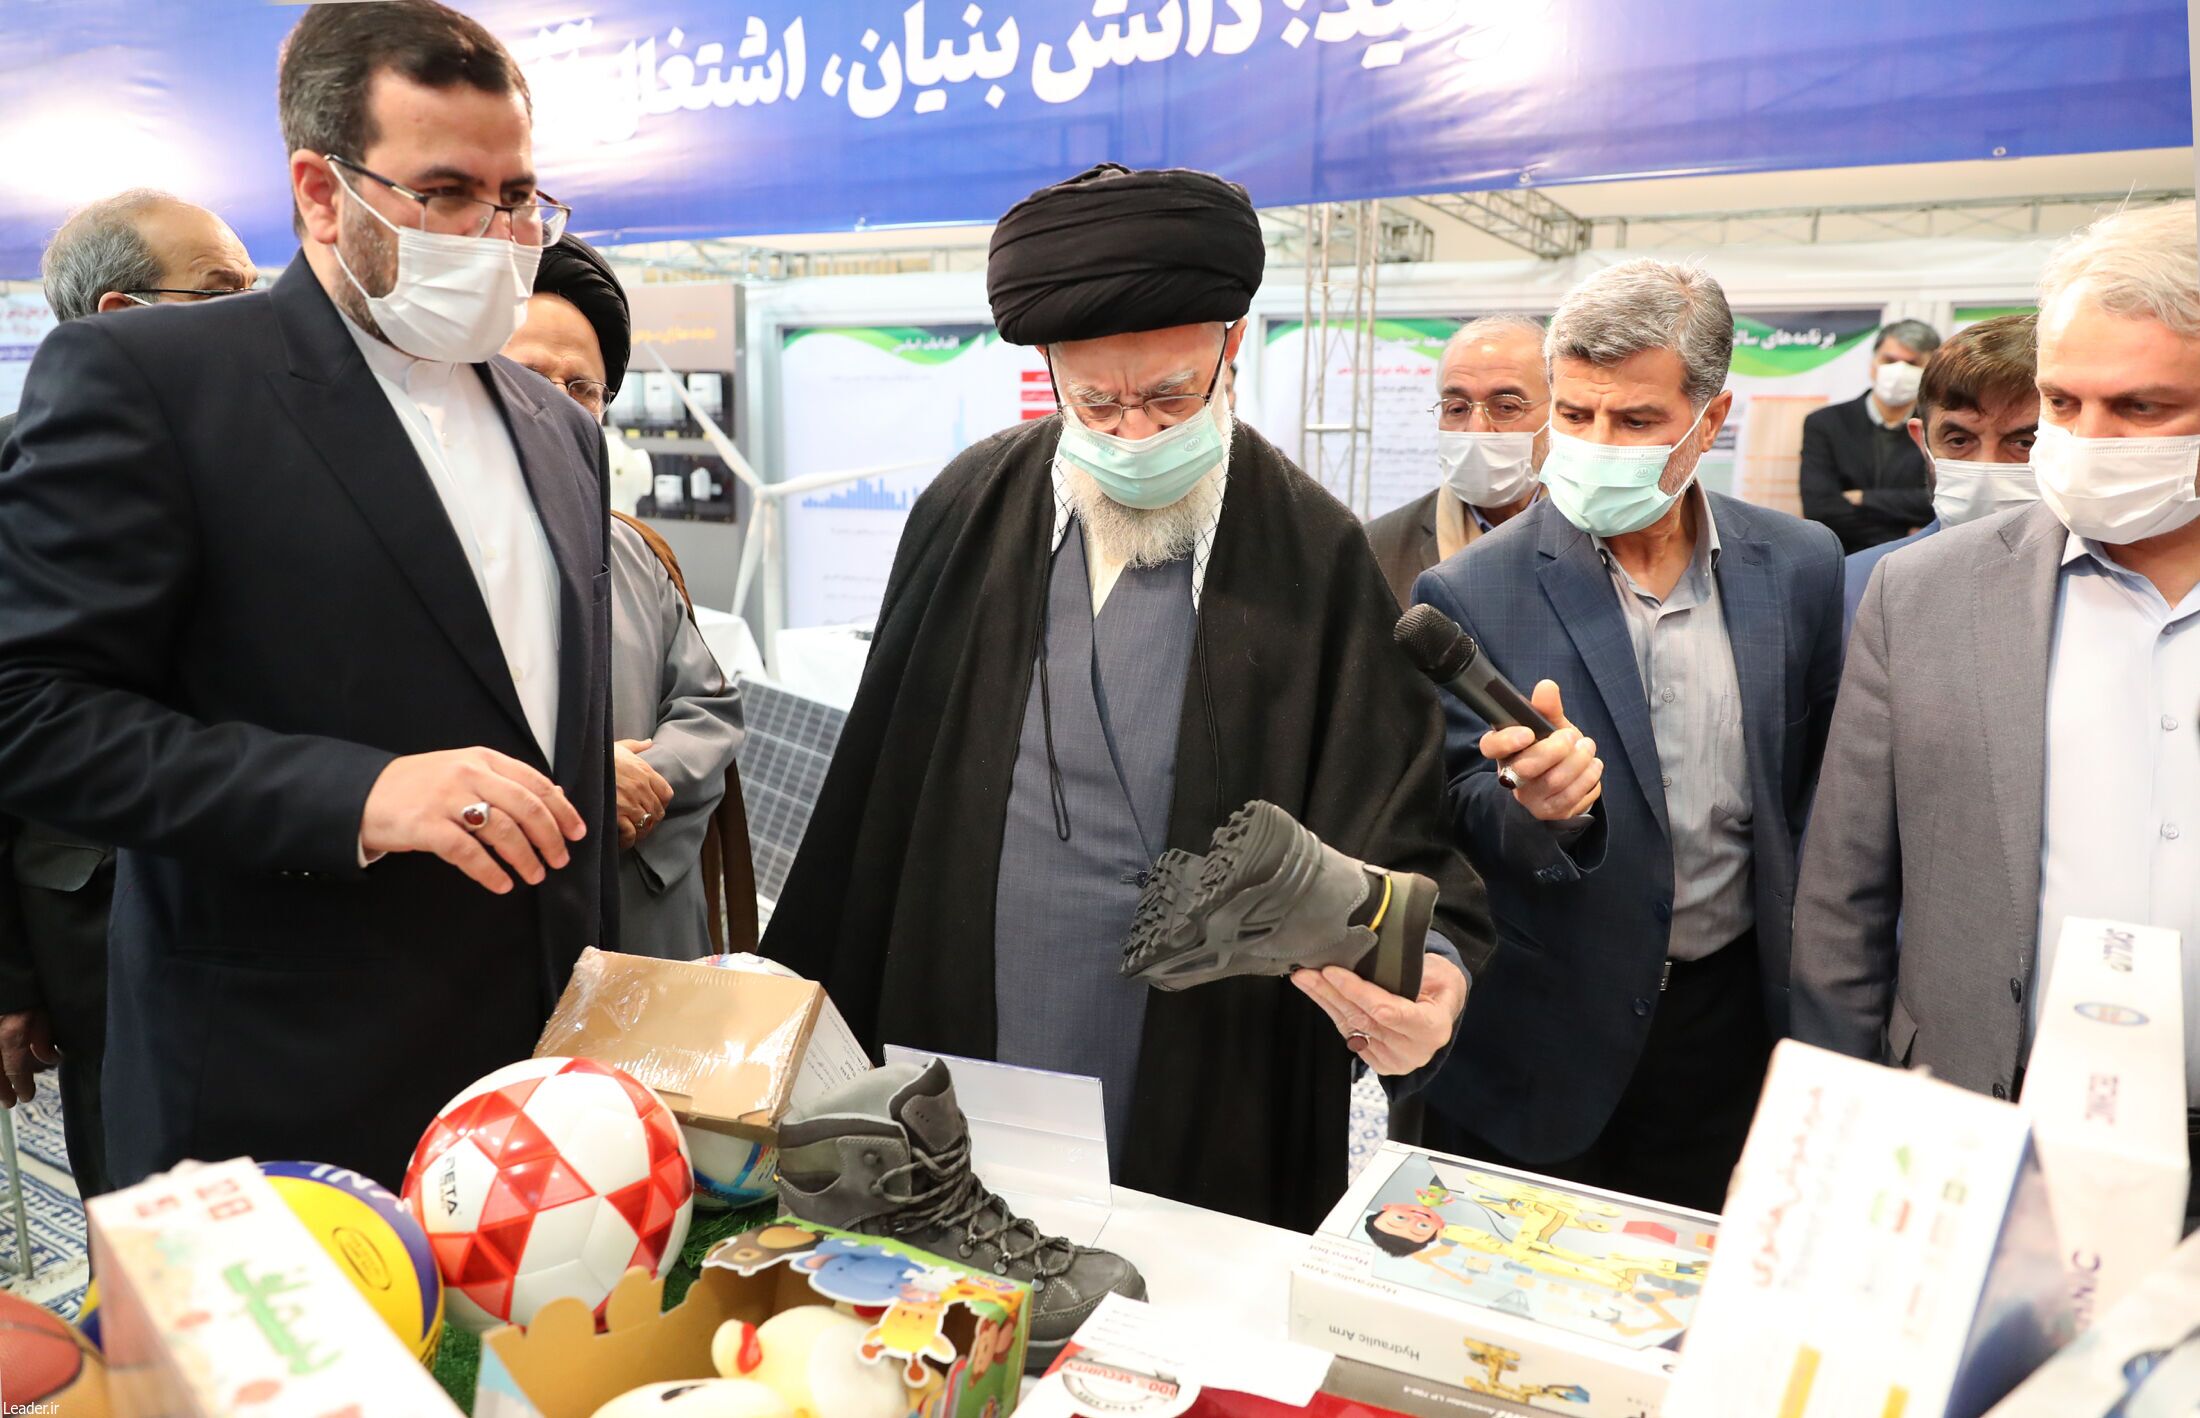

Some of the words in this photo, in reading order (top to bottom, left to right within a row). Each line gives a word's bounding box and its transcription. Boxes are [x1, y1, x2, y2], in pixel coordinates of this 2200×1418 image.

[1328, 1324, 1356, 1341] Arm
[1358, 1333, 1420, 1361] Hydraulic
[1066, 1361, 1133, 1384] SECURITY
